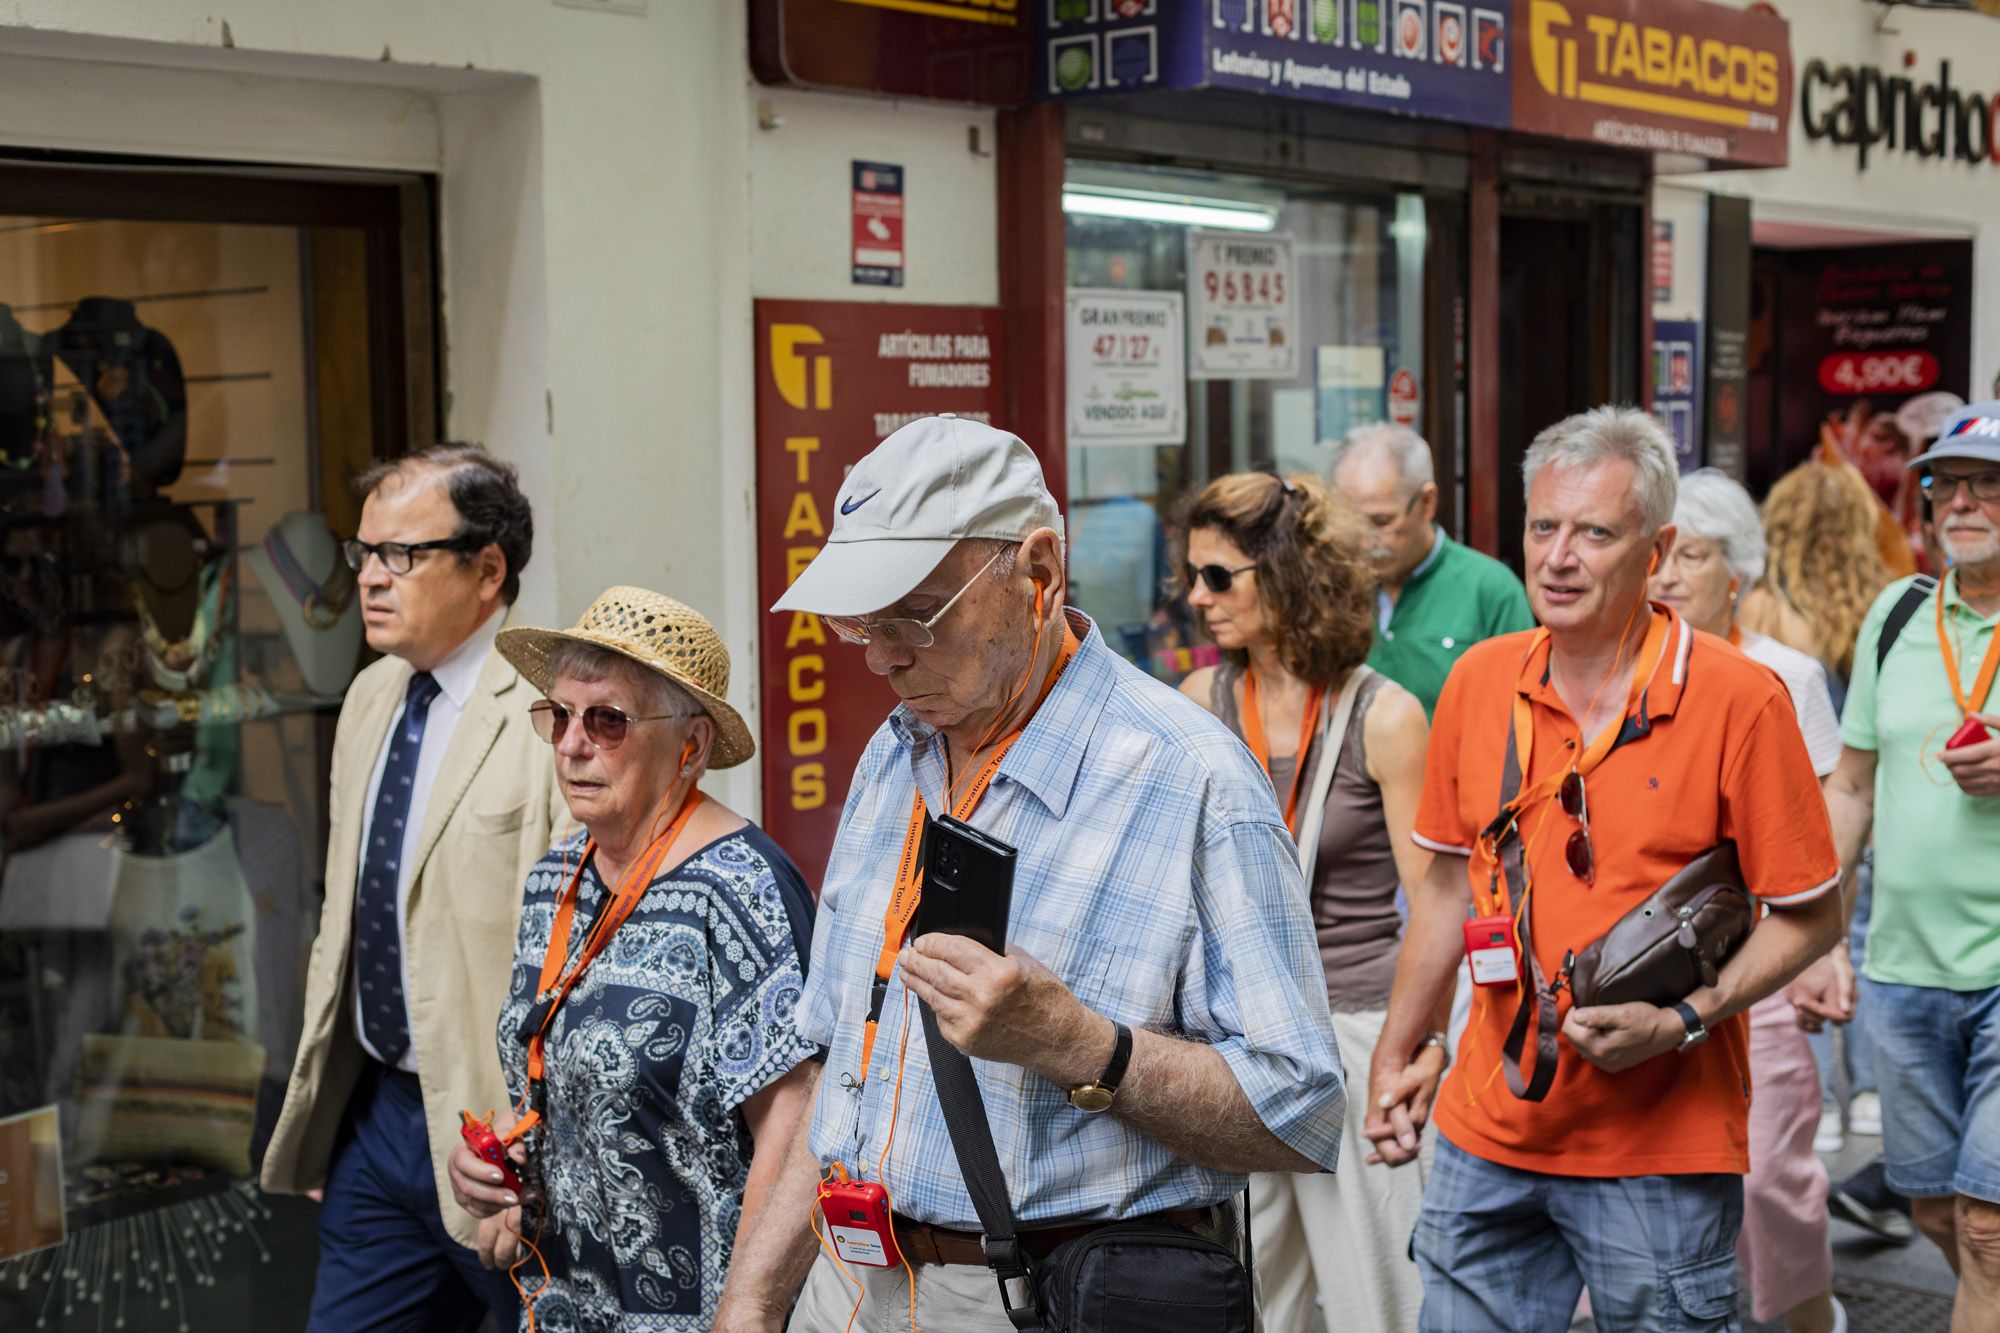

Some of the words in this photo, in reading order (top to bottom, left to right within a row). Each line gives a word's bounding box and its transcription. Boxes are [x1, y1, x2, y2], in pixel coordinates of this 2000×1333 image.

[1212, 47, 1270, 79] Loterías
[1271, 61, 1282, 87] y
[1283, 58, 1343, 89] Apuestas
[1345, 66, 1366, 93] del
[1368, 70, 1412, 99] Estado
[1586, 14, 1780, 107] TABACOS
[1226, 245, 1279, 266] PREMIO
[1203, 269, 1285, 304] 96845
[1080, 306, 1119, 327] GRAN
[1121, 308, 1167, 329] PREMIO
[878, 328, 951, 358] ARTÍCULOS
[953, 334, 991, 358] PARA
[907, 363, 991, 388] FUMADORES
[1833, 355, 1924, 392] 4,90€
[957, 768, 992, 819] nnovations
[900, 821, 919, 883] Innovations
[893, 884, 906, 914] Tours
[900, 884, 923, 924] Innovat
